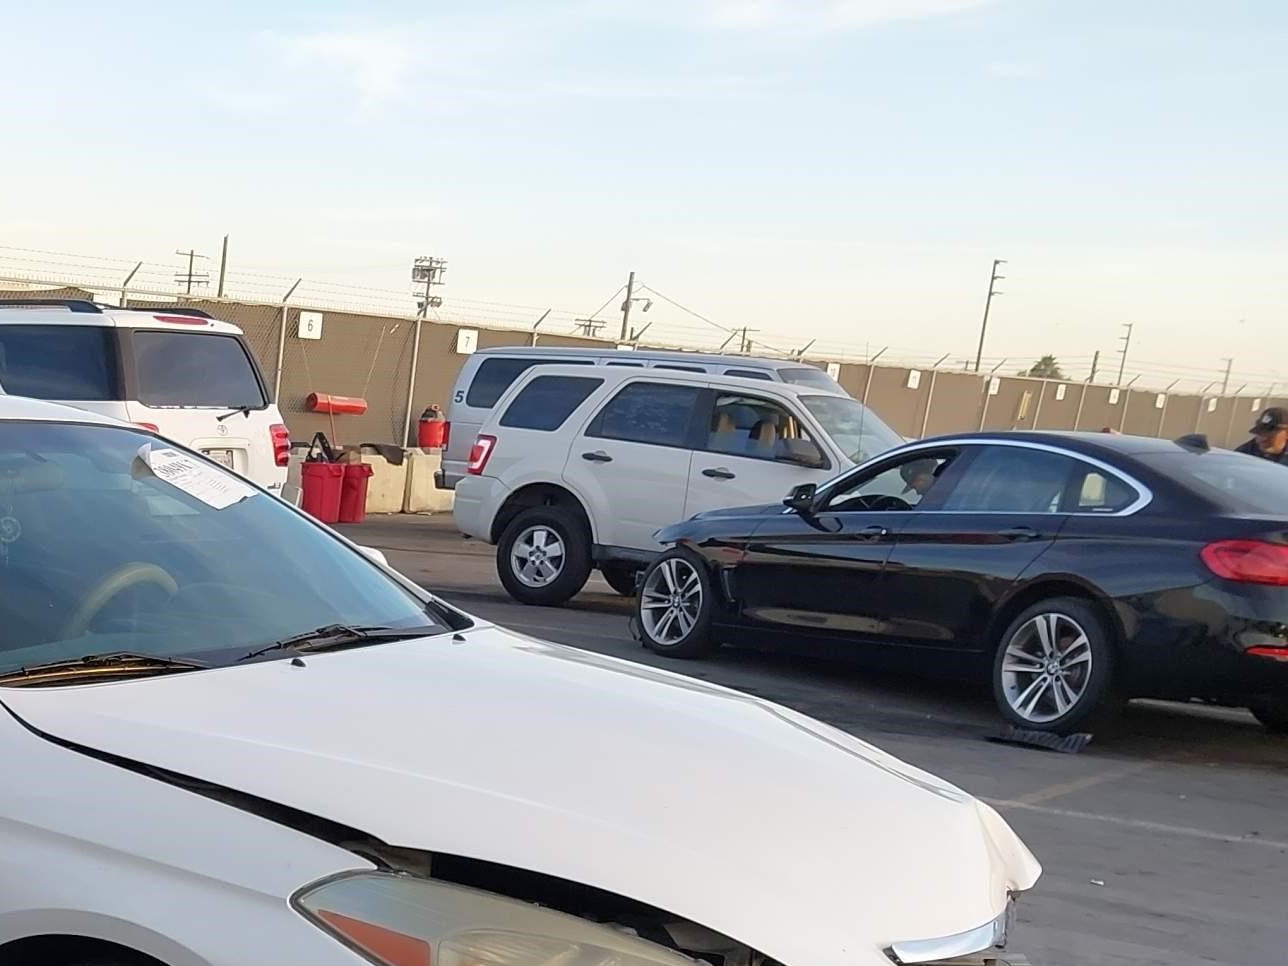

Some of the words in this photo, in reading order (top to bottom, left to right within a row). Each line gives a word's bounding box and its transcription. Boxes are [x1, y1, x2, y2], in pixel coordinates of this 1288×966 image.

[307, 319, 314, 332] 6
[465, 336, 471, 348] 7
[454, 390, 465, 404] 5
